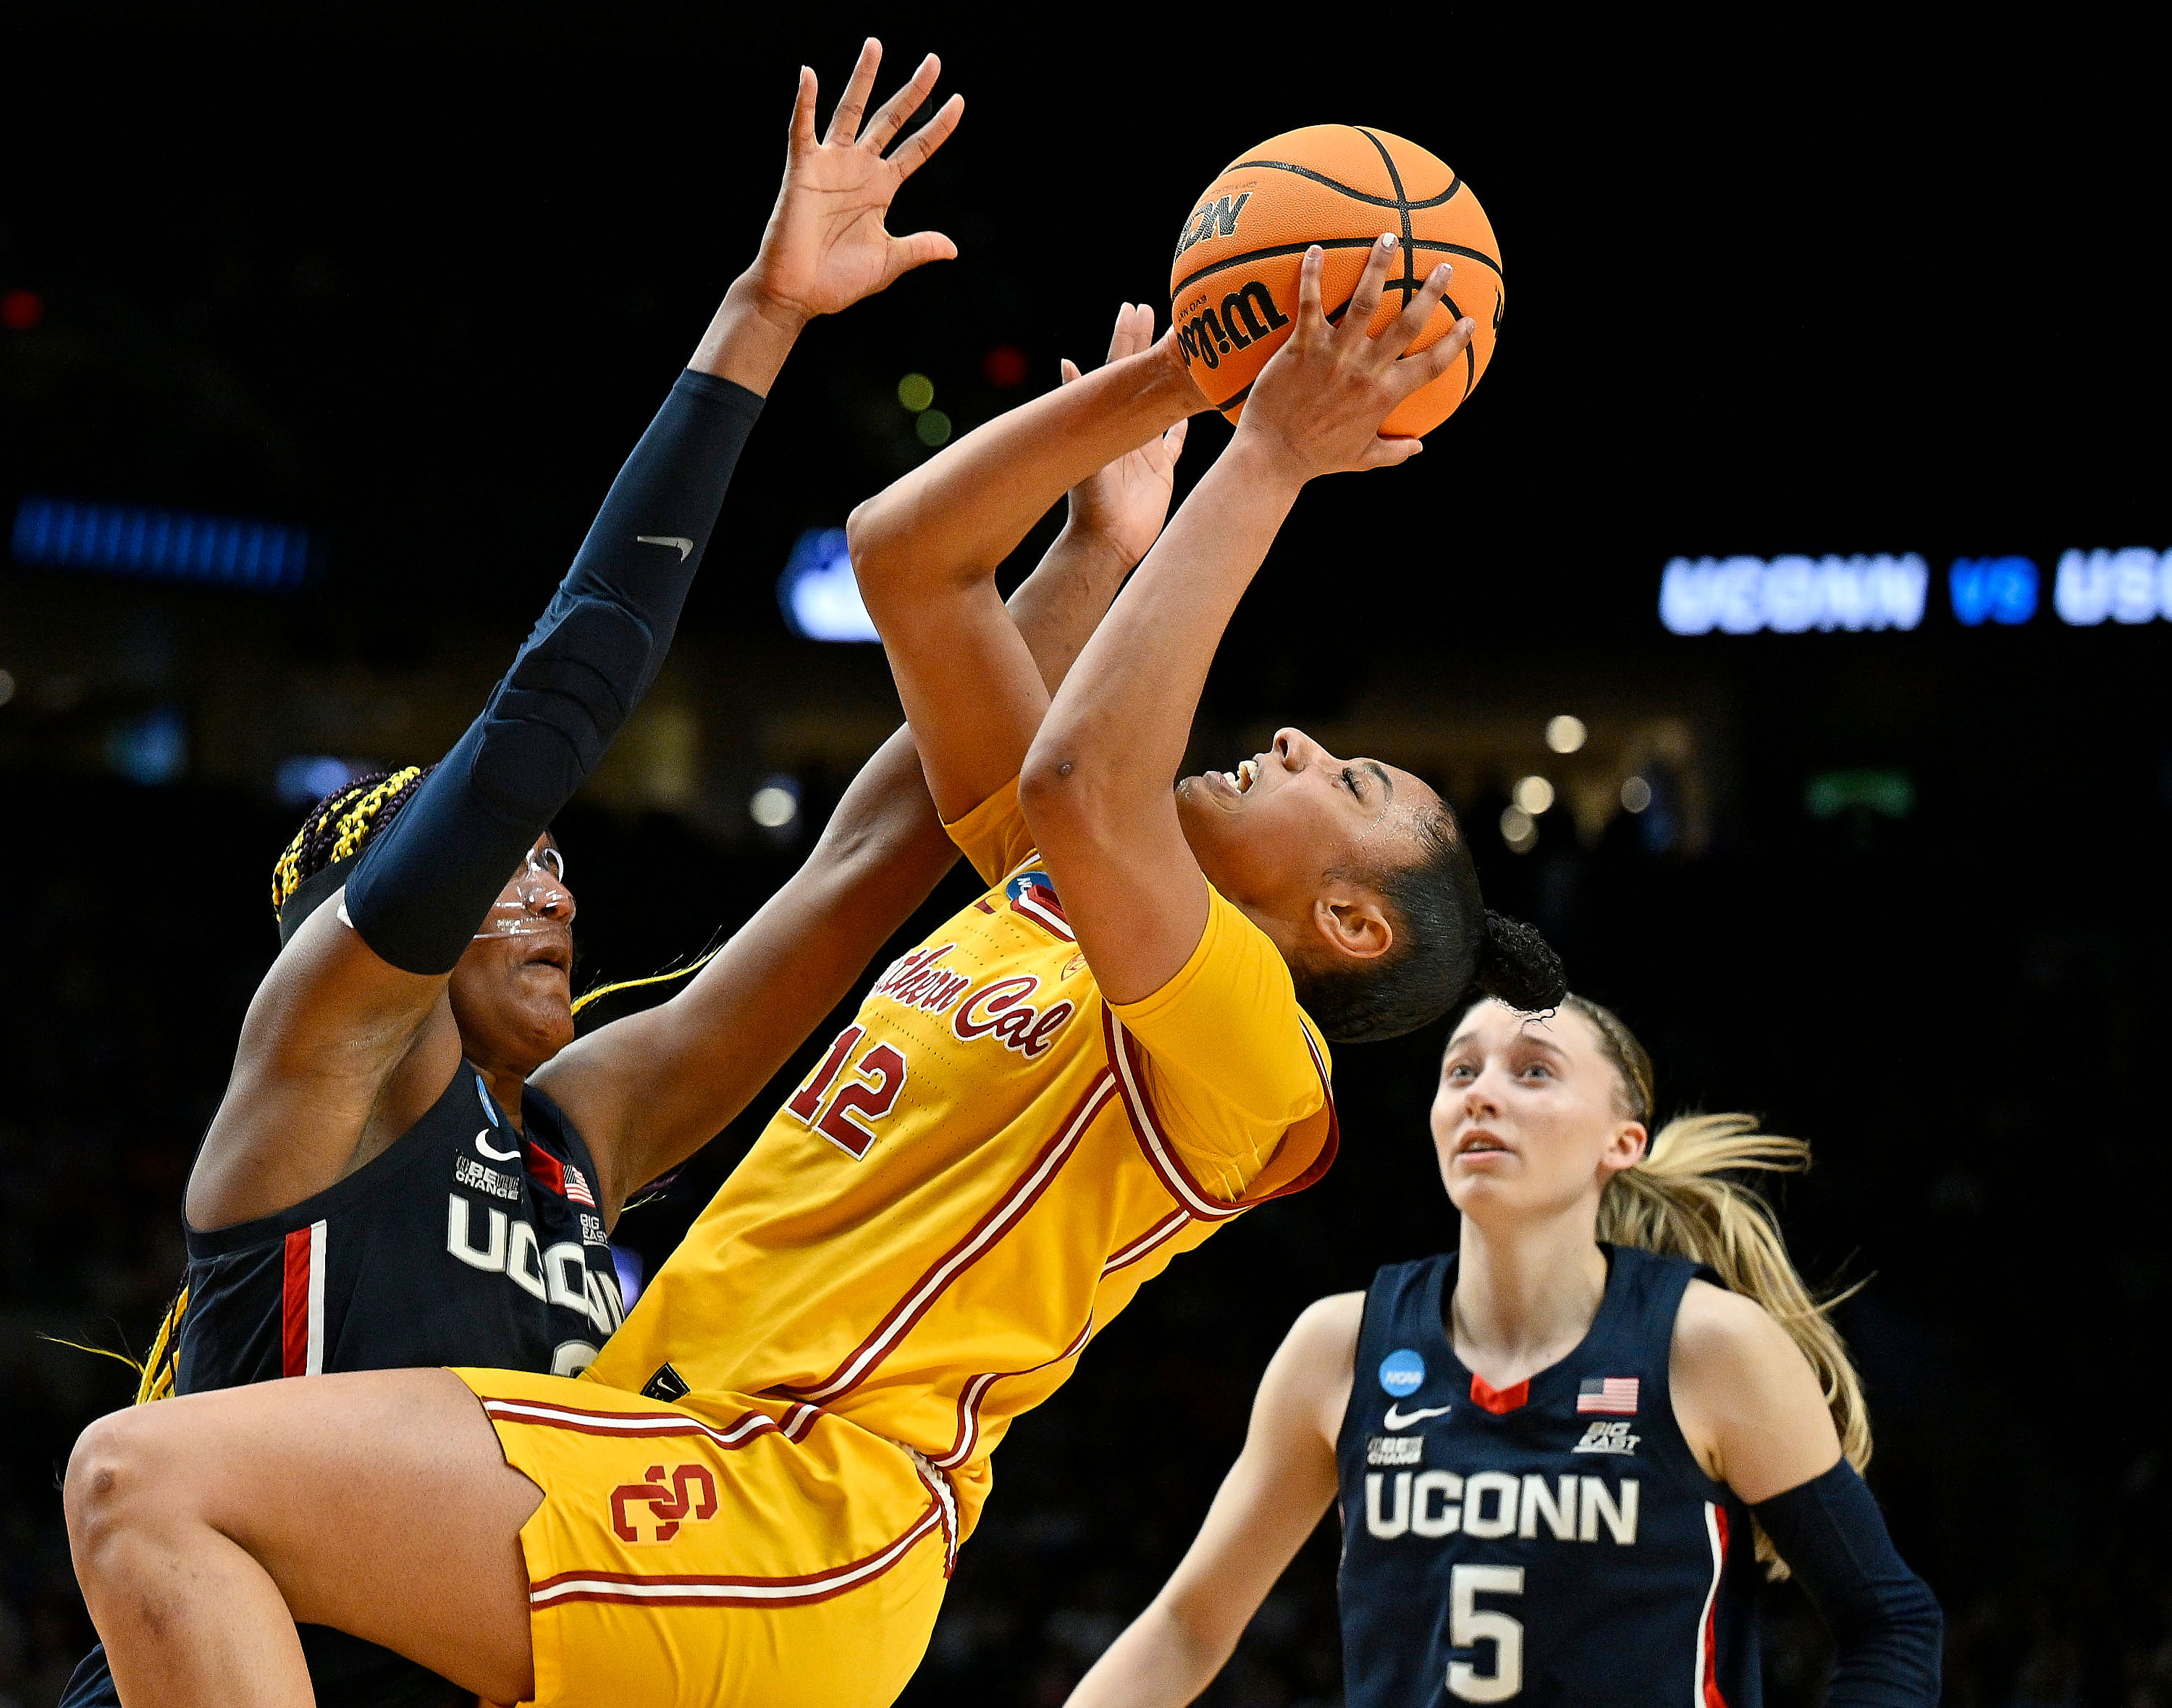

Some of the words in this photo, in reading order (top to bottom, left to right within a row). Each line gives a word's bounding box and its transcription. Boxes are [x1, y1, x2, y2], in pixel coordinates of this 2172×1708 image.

[1659, 552, 1929, 635] UCONN
[1948, 555, 2040, 626] VS
[2054, 547, 2172, 626] US
[951, 975, 1075, 1059] Cal
[784, 1022, 908, 1161] 12
[456, 1169, 519, 1201] CHANGE
[580, 1213, 599, 1230] BIG
[1365, 1469, 1641, 1546] UCONN
[1445, 1562, 1525, 1704] 5
